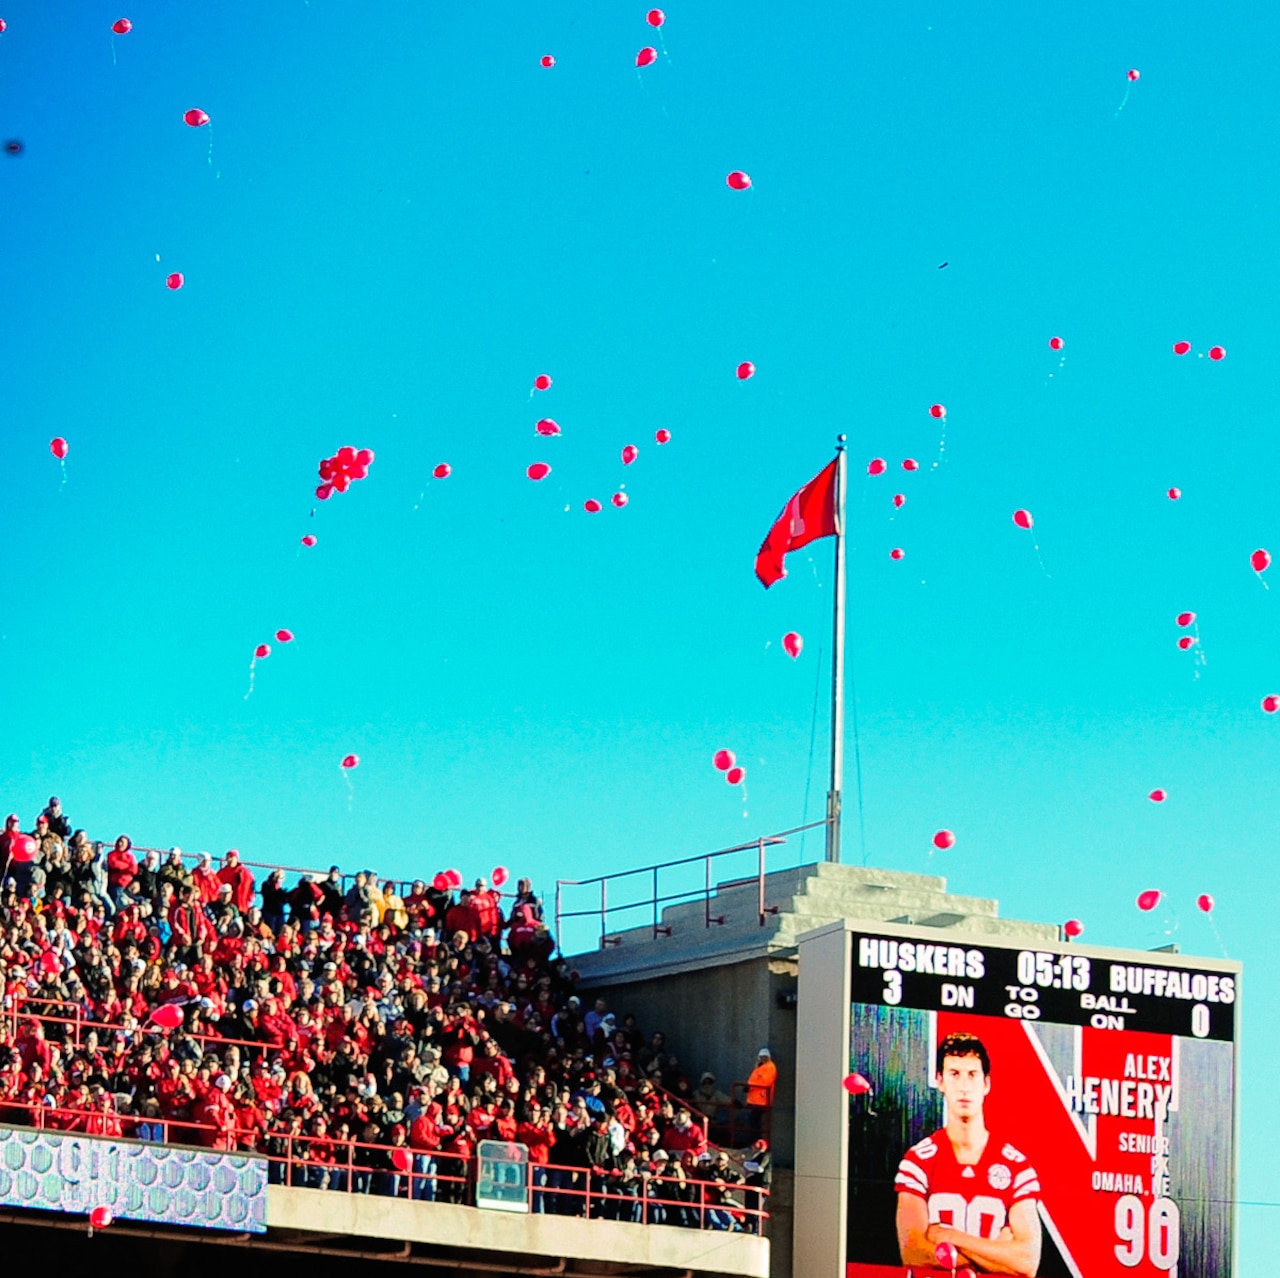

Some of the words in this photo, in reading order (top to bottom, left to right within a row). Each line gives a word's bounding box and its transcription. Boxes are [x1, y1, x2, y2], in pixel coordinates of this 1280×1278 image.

[859, 937, 986, 979] HUSKERS
[1017, 950, 1091, 991] 05:13
[882, 969, 903, 1005] 3
[940, 983, 975, 1009] DN
[1004, 985, 1039, 1002] TO
[1109, 964, 1236, 1004] BUFFALOES
[1004, 1003, 1041, 1020] GO
[1080, 993, 1137, 1013] BALL
[1090, 1014, 1125, 1031] ON
[1191, 1003, 1211, 1038] 0
[1123, 1053, 1171, 1082] ALEX
[1066, 1075, 1172, 1120] HENERY
[1118, 1132, 1170, 1155] SENIOR
[1114, 1195, 1180, 1270] 90
